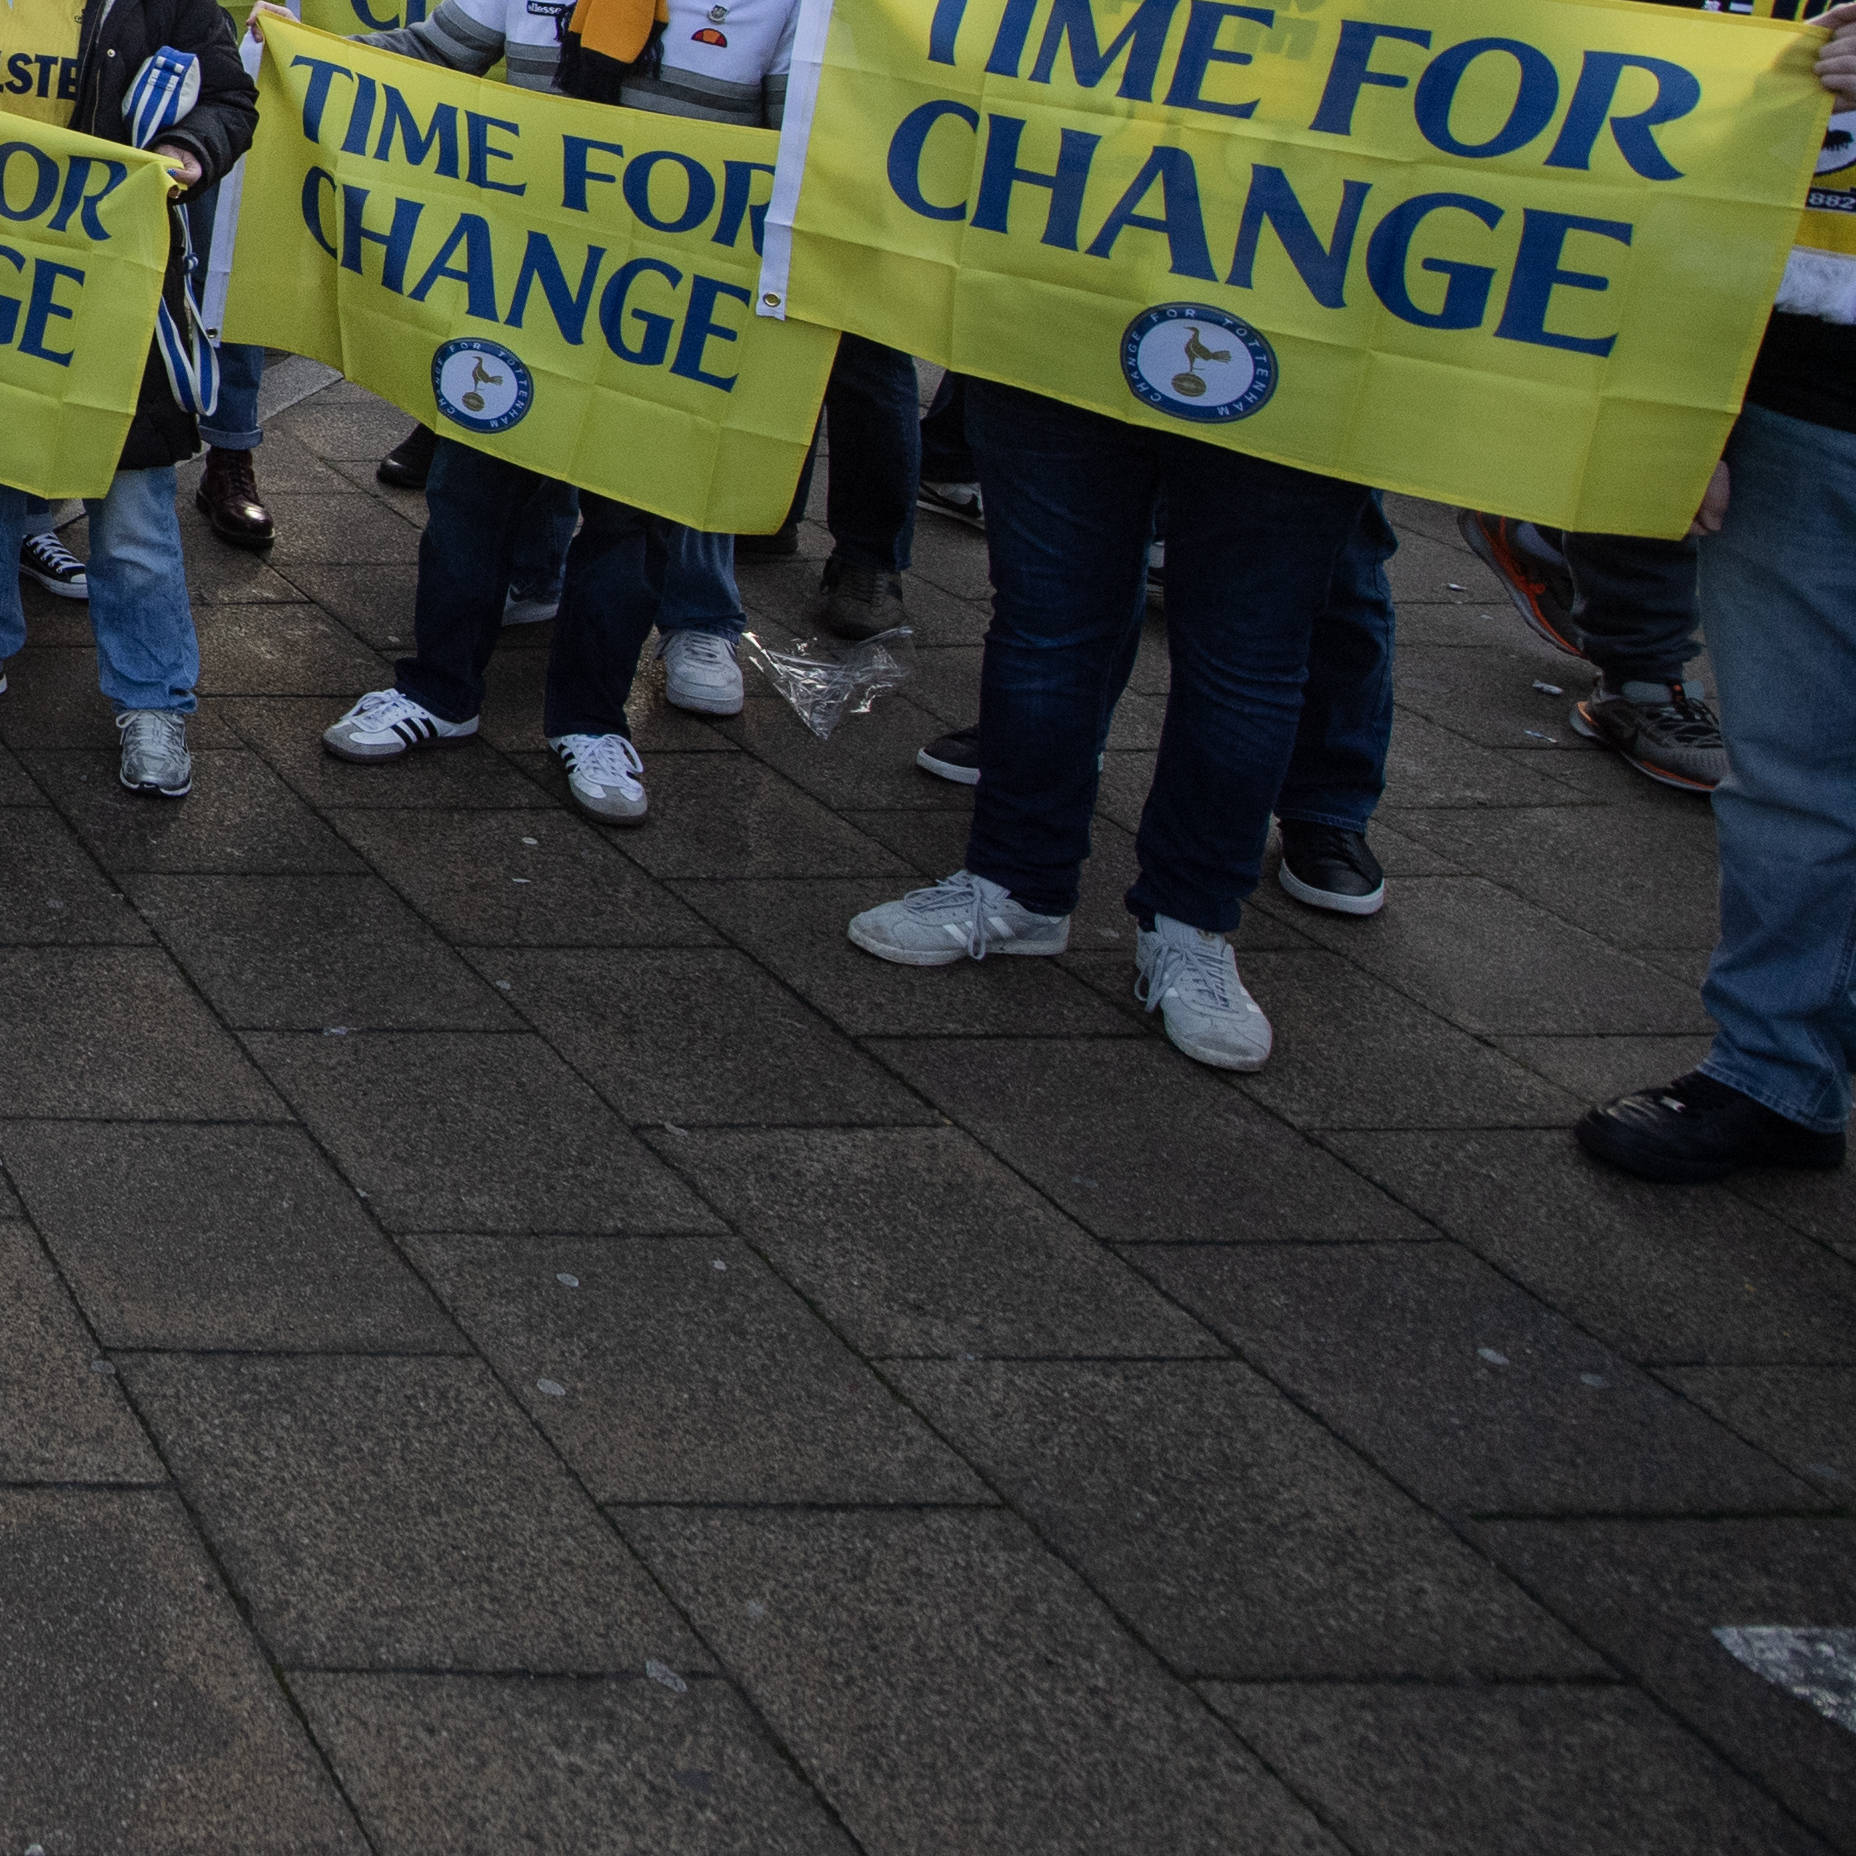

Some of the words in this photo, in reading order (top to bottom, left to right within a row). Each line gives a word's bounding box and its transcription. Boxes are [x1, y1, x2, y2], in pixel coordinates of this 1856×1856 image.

[290, 54, 522, 191] TIME
[561, 134, 780, 250] FOR
[1310, 19, 1701, 181] FOR
[301, 164, 753, 392] CHANGE
[886, 98, 1634, 358] CHANGE
[448, 341, 482, 353] FOR
[489, 351, 529, 428] TOTTENHAM
[1127, 330, 1162, 403] CHANGE
[1149, 308, 1197, 323] FOR
[1216, 317, 1269, 417] TOTTENHAM
